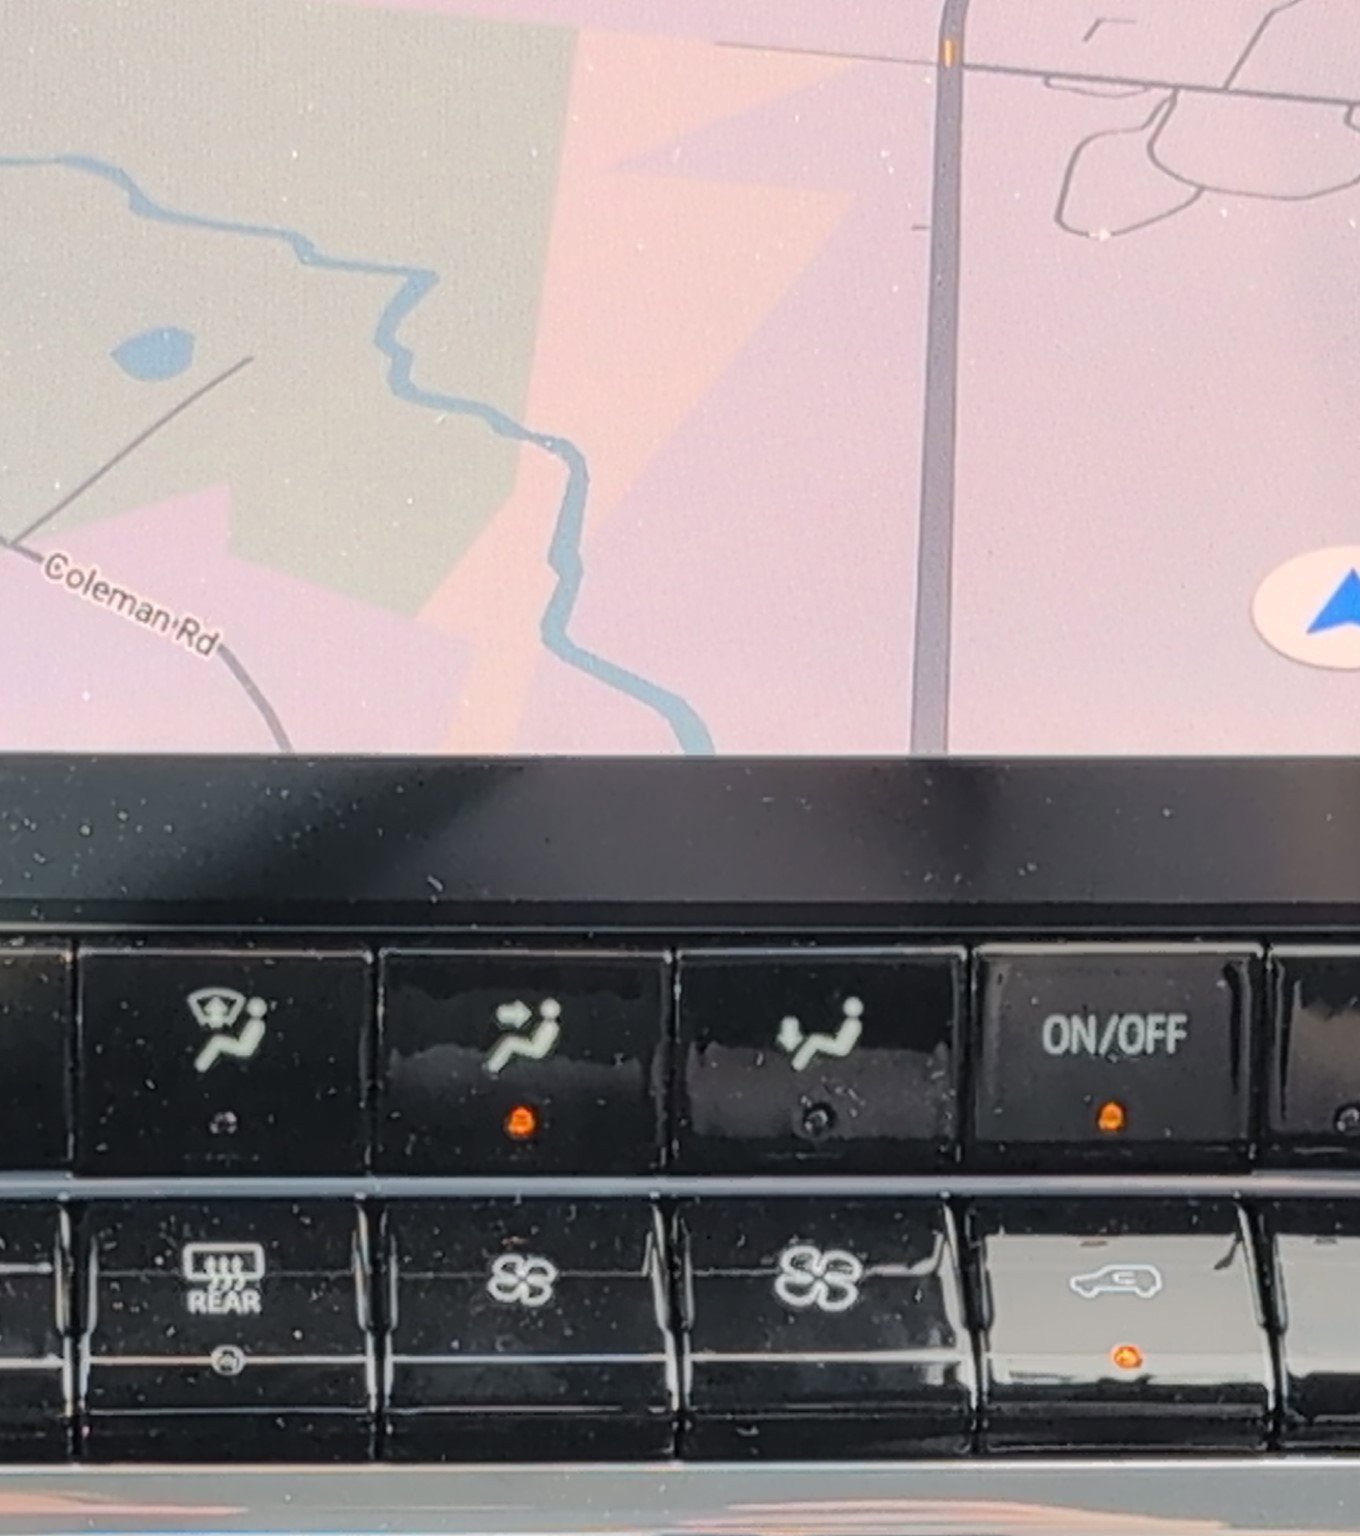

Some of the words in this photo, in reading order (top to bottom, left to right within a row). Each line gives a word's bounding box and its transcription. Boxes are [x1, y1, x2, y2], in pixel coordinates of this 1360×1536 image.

[45, 553, 171, 632] Coleman
[176, 617, 220, 655] Rd
[1042, 1014, 1188, 1055] ON/OFF
[187, 1289, 261, 1314] REAR
